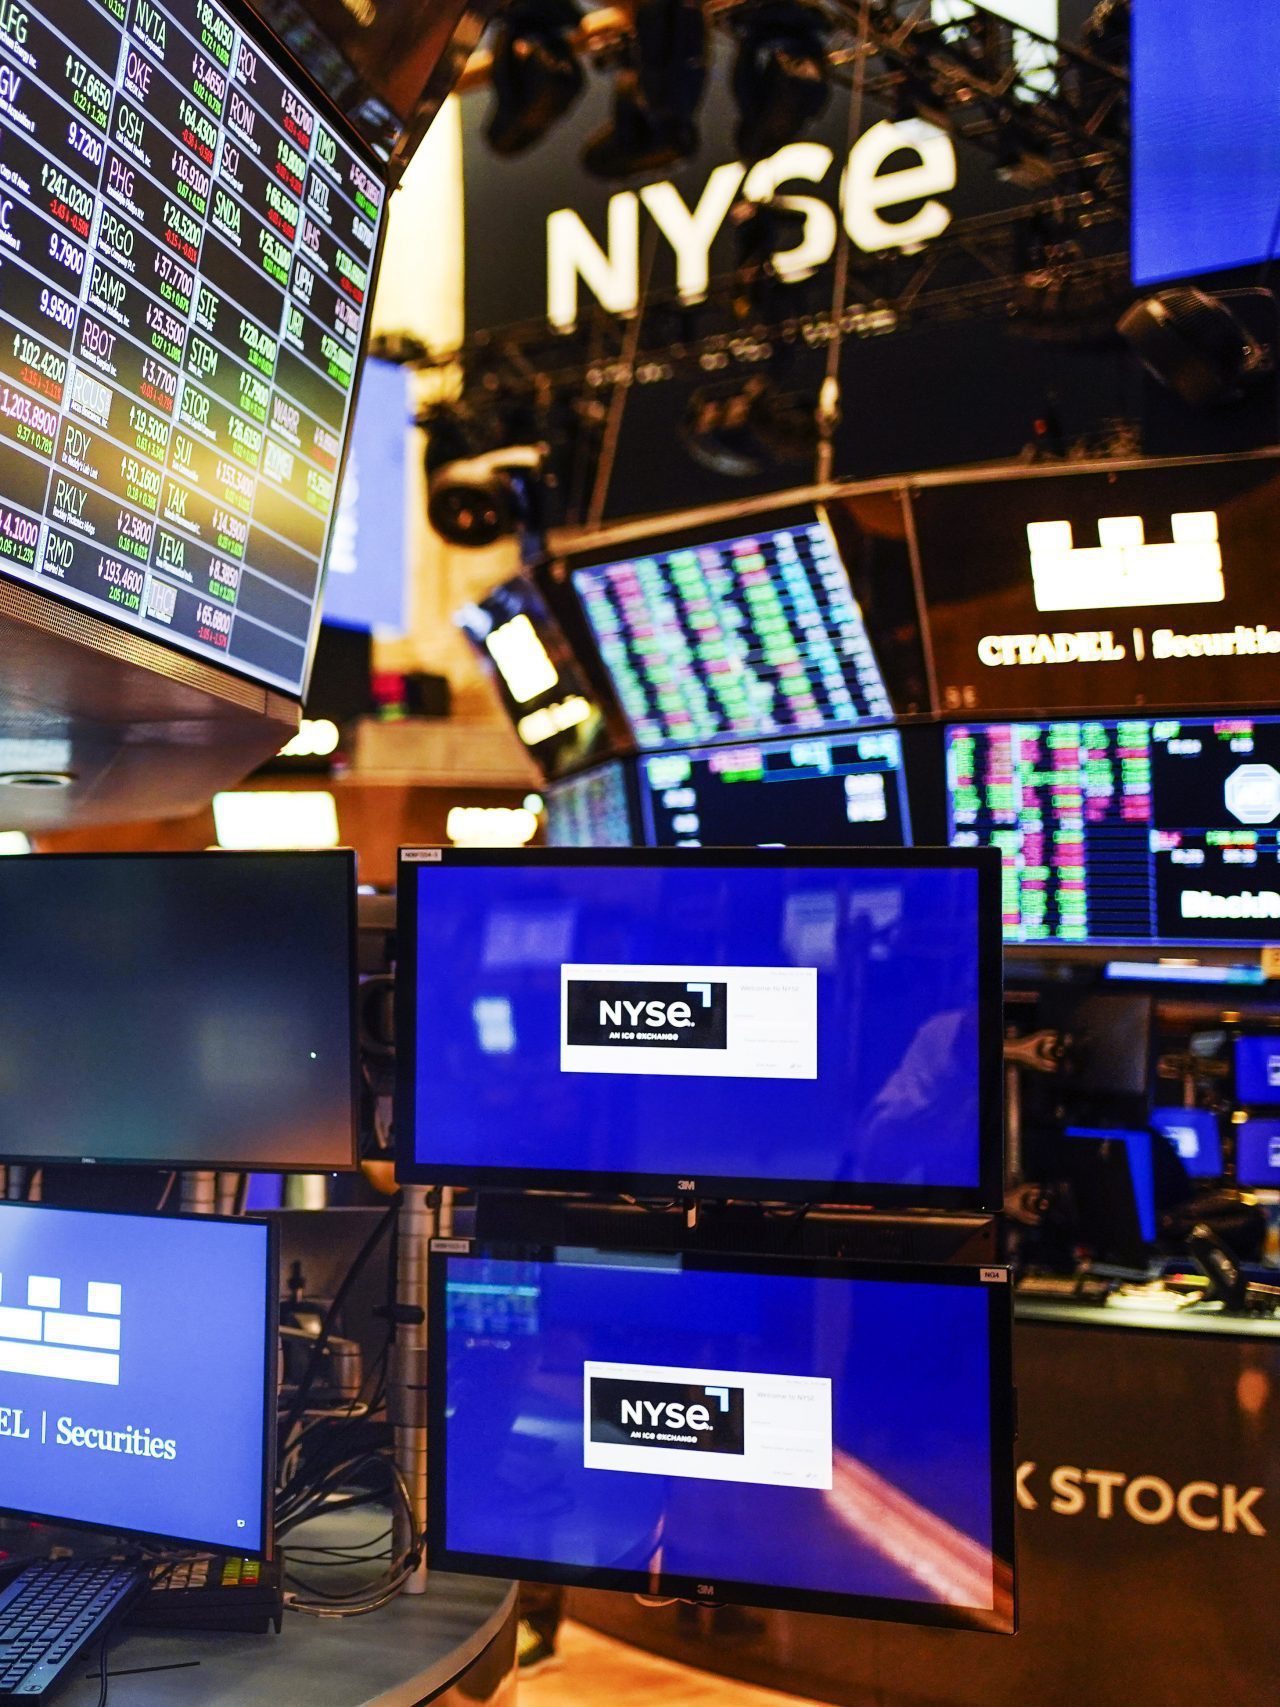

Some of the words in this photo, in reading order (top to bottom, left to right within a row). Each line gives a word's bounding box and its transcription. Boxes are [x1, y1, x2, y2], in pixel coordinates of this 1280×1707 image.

[135, 0, 166, 49] NVTA
[201, 4, 233, 51] 88.4050
[127, 52, 152, 94] OKE
[197, 57, 225, 100] 3.4650
[239, 44, 257, 84] ROL
[72, 61, 111, 111] 17.6650
[118, 104, 144, 147] OSH
[230, 93, 256, 135] RONI
[68, 121, 102, 166] 9.7200
[222, 142, 240, 176] SCI
[47, 168, 93, 221] 241.0200
[109, 157, 135, 198] PHG
[177, 155, 209, 198] 16.9100
[170, 206, 201, 248] 24.5200
[214, 190, 241, 234] SNDA
[49, 232, 84, 275] 9.7900
[100, 210, 134, 257] PRGO
[91, 264, 126, 308] RAMP
[159, 255, 193, 297] 37.7700
[40, 289, 76, 330] 9.9500
[198, 288, 219, 323] STE
[82, 318, 116, 360] RBOT
[151, 307, 184, 347] 25.3500
[20, 338, 66, 384] 102.4200
[190, 337, 218, 377] STEM
[72, 372, 106, 413] RCUS
[148, 360, 177, 396] 3.7700
[0, 388, 57, 438] 1,203.8900
[182, 386, 210, 424] STOR
[64, 425, 91, 461] RDY
[134, 409, 168, 445] 19.5000
[174, 435, 192, 466] SUI
[127, 459, 160, 495] 50.1600
[55, 479, 88, 517] RKLY
[168, 482, 189, 516] TAK
[3, 512, 38, 547] 4.1000
[122, 514, 152, 545] 2.5800
[158, 532, 185, 568] TEVA
[46, 533, 74, 568] RMD
[104, 559, 144, 595] 193.4600
[977, 630, 1126, 667] CITADEL
[678, 1180, 695, 1191] 3M
[55, 1416, 177, 1460] Securities
[1049, 1464, 1267, 1537] STOCK
[697, 1584, 714, 1596] 3M
